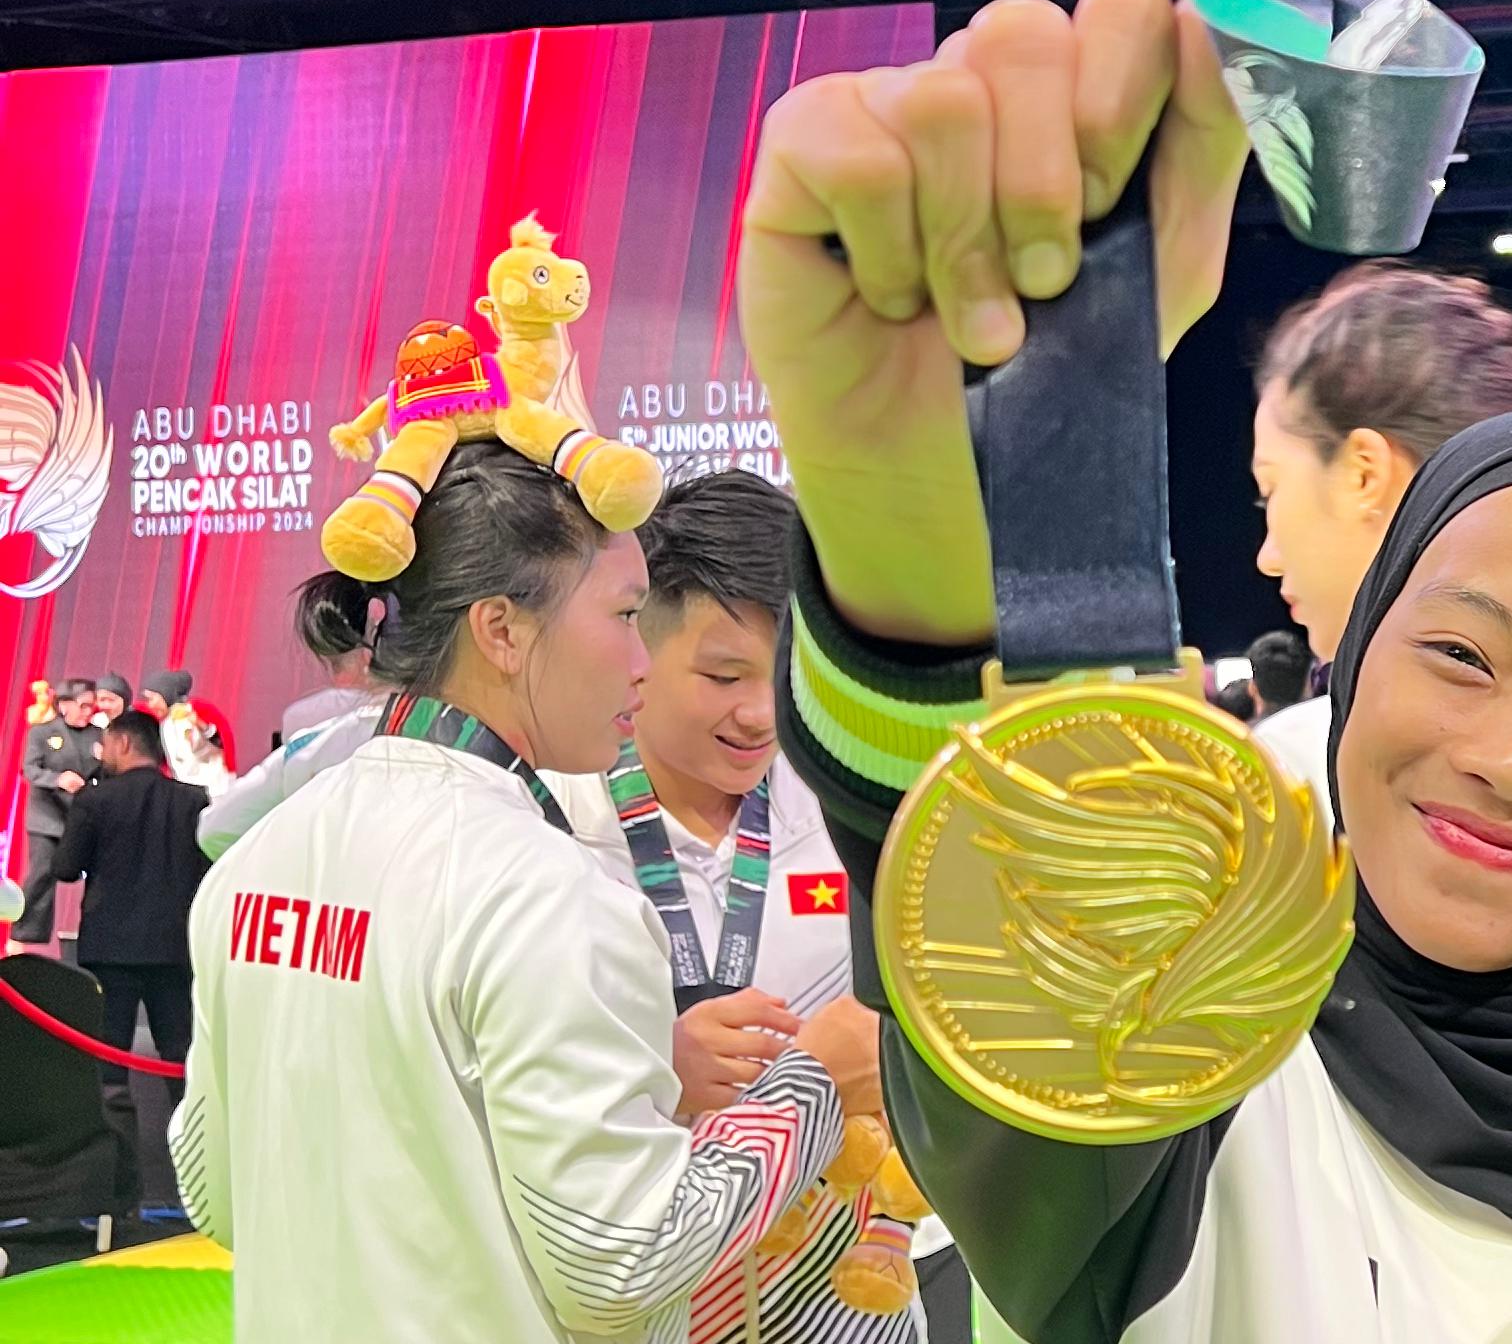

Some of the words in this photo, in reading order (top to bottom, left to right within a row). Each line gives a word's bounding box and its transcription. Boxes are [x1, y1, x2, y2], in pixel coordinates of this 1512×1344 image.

[619, 383, 686, 419] ABU
[132, 406, 195, 441] ABU
[212, 401, 312, 437] DHABI
[649, 422, 729, 452] JUNIOR
[132, 442, 188, 479] 20th
[193, 439, 313, 476] WORLD
[132, 476, 237, 514] PENCAK
[242, 473, 313, 509] SILAT
[133, 512, 266, 537] CHAMPIONSHIP
[272, 511, 313, 532] 2024
